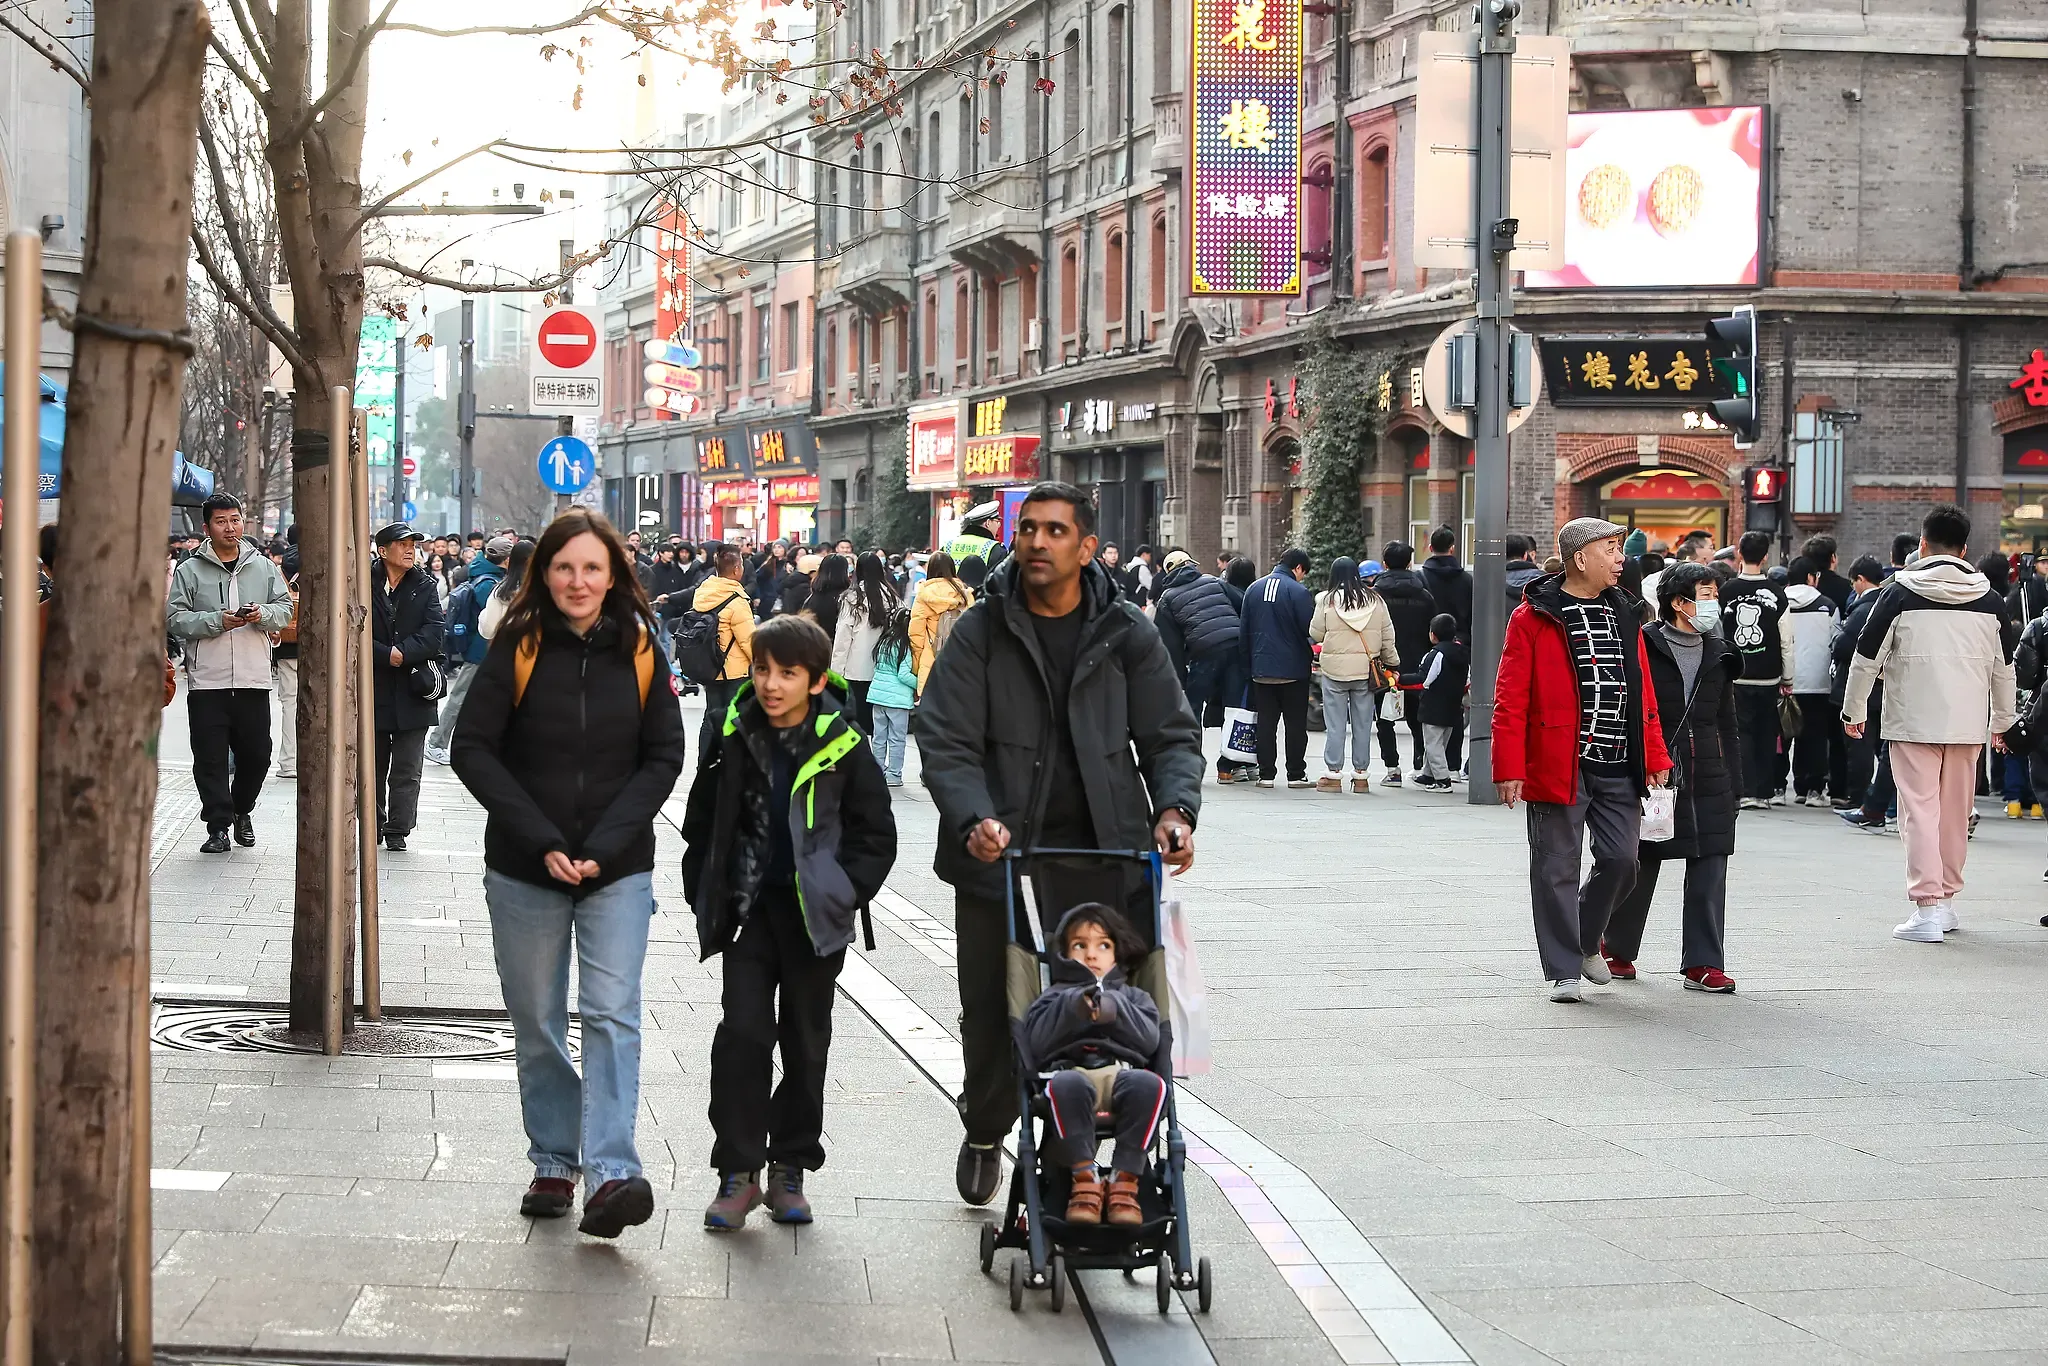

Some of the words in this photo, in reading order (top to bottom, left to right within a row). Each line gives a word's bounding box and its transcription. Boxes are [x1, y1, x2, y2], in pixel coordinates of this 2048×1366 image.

[537, 382, 597, 401] 除特种车辆外
